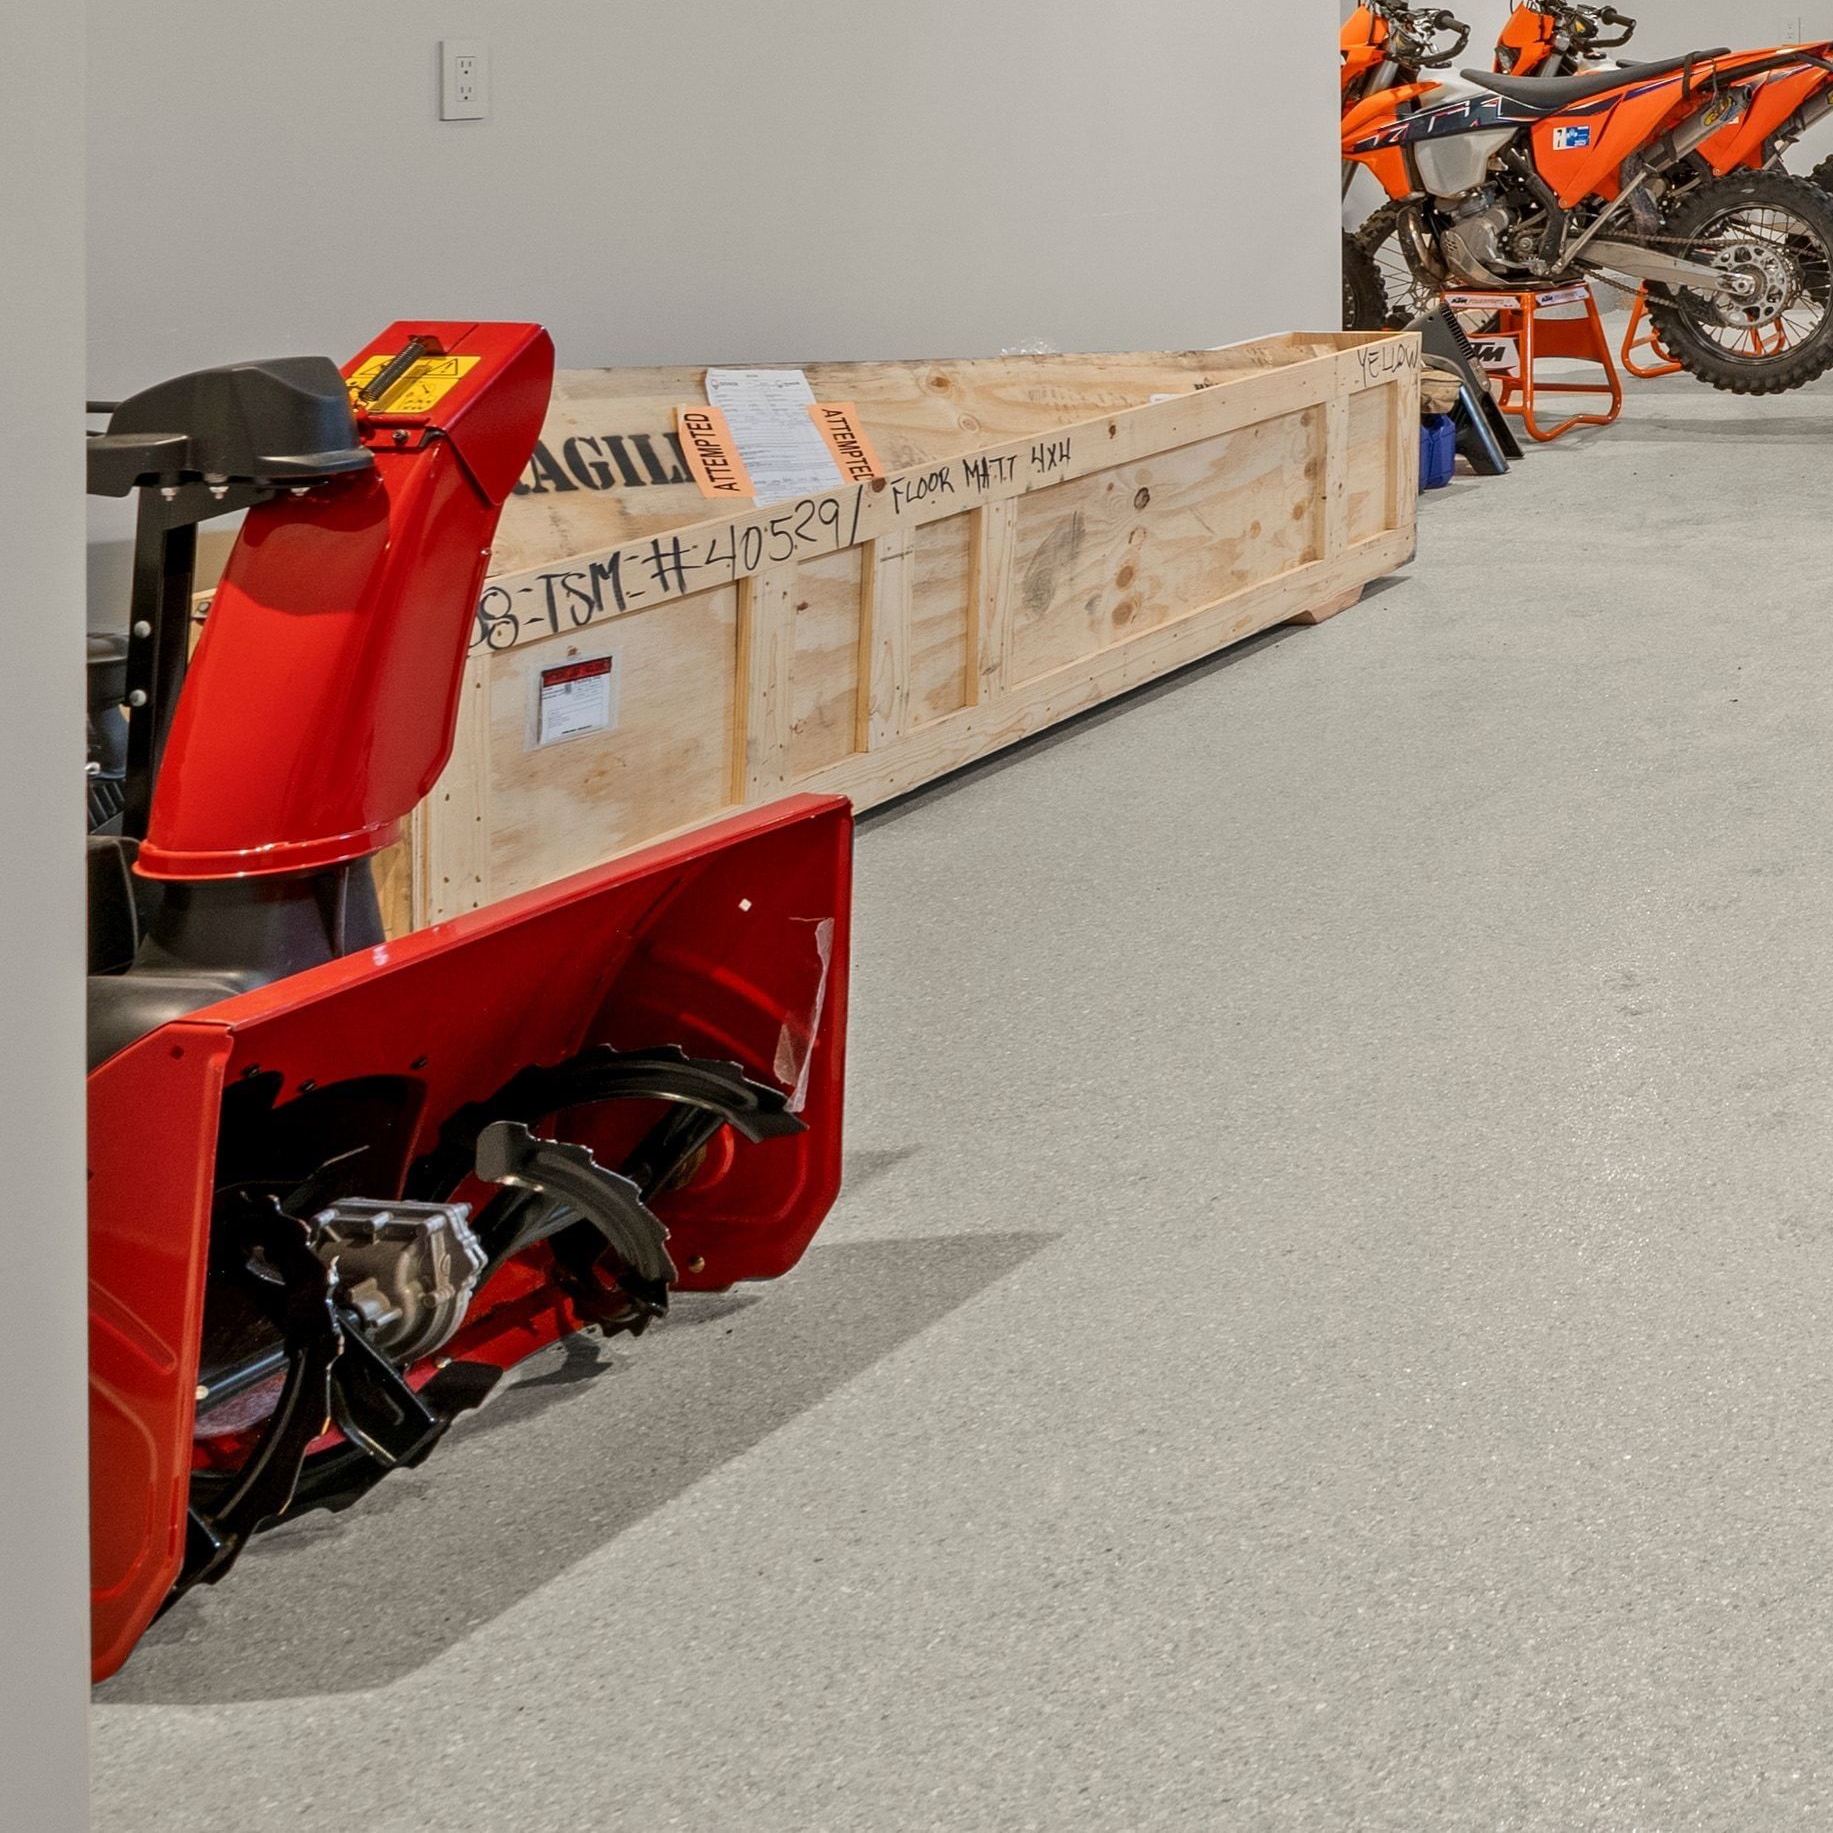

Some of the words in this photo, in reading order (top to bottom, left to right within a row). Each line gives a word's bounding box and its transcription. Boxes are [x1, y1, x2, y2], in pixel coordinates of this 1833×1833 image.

[1357, 340, 1420, 387] YELLOW
[1469, 341, 1506, 362] TM
[683, 413, 741, 492] ATTEMPTED
[890, 466, 955, 515] FLOOR
[962, 455, 1018, 494] MATT
